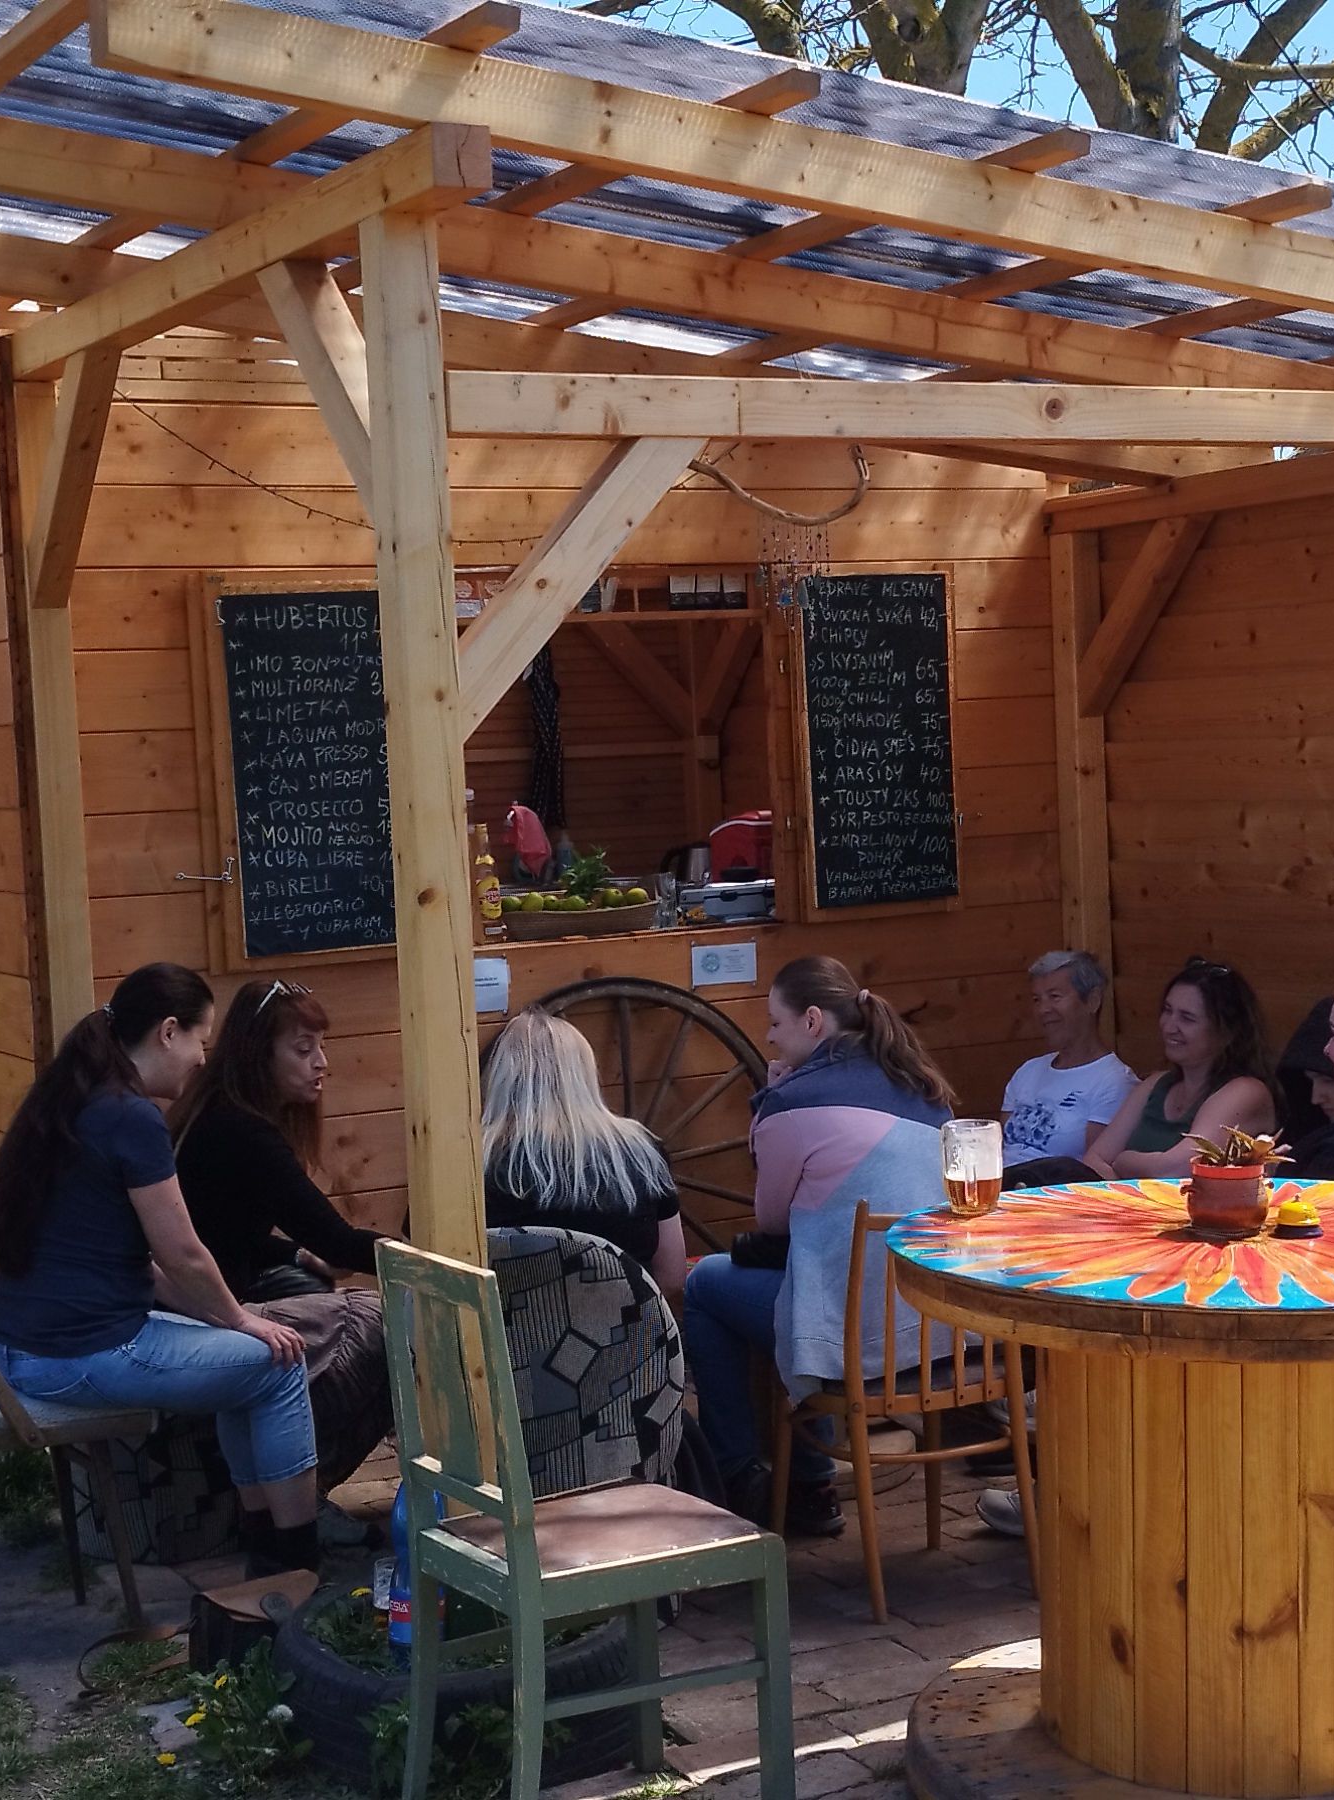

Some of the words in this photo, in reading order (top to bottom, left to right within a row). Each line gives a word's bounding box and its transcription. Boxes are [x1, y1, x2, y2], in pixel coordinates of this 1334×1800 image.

[254, 603, 368, 630] HUBERTUS
[266, 725, 338, 746] LAGUNA
[259, 747, 307, 770] KÁVA
[313, 744, 369, 767] PRESSO
[268, 774, 299, 796] ČAJ
[320, 767, 372, 788] MEDEM
[833, 759, 904, 785] ARAŠÍDY
[268, 798, 364, 821] PROSECCO
[833, 787, 889, 808] TOUSTY
[264, 849, 309, 869] CUBA
[316, 851, 364, 868] LIBRE
